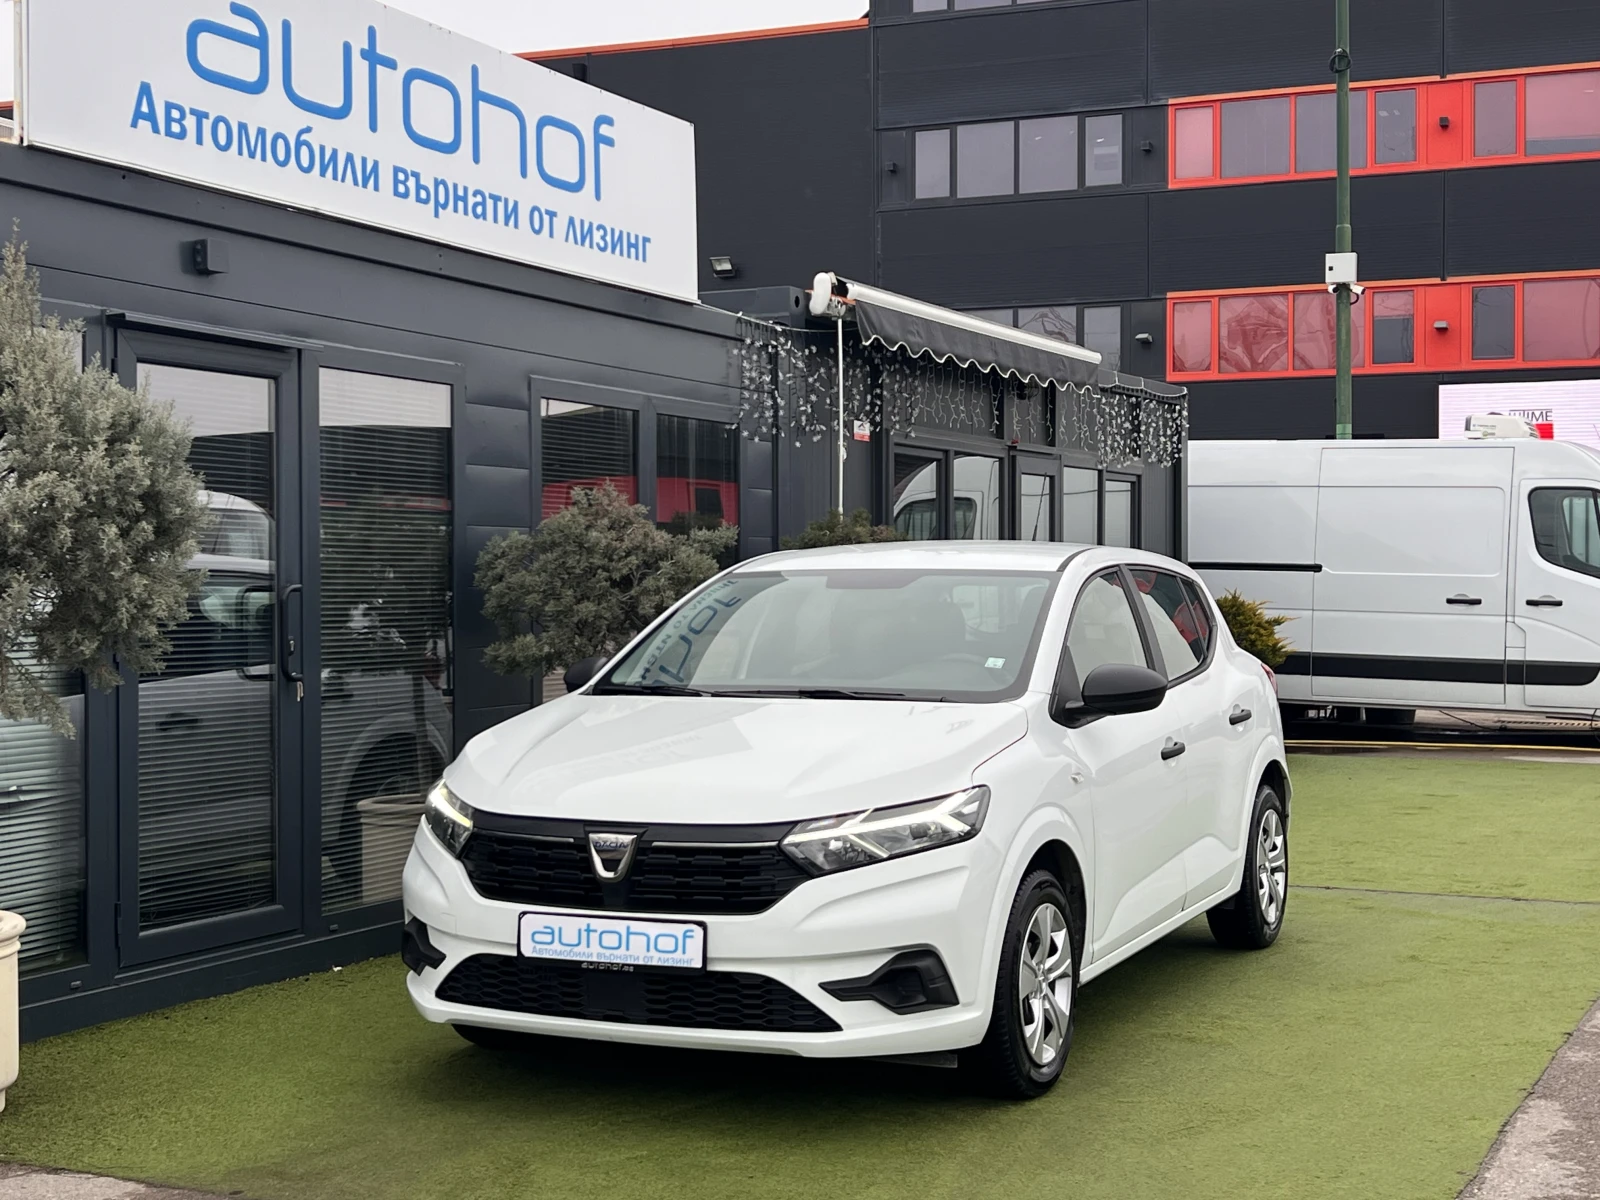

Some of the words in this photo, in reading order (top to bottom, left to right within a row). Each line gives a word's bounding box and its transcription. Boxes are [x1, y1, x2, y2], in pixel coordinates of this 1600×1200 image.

[186, 1, 616, 202] autohof
[130, 80, 381, 193] Автомобили
[392, 163, 520, 231] върнати
[528, 205, 558, 238] от
[563, 214, 652, 264] лизинг
[530, 923, 695, 955] autohof
[531, 945, 594, 959] Автомобили
[596, 952, 640, 963] върнати
[642, 955, 654, 964] от
[656, 957, 695, 967] лизинг
